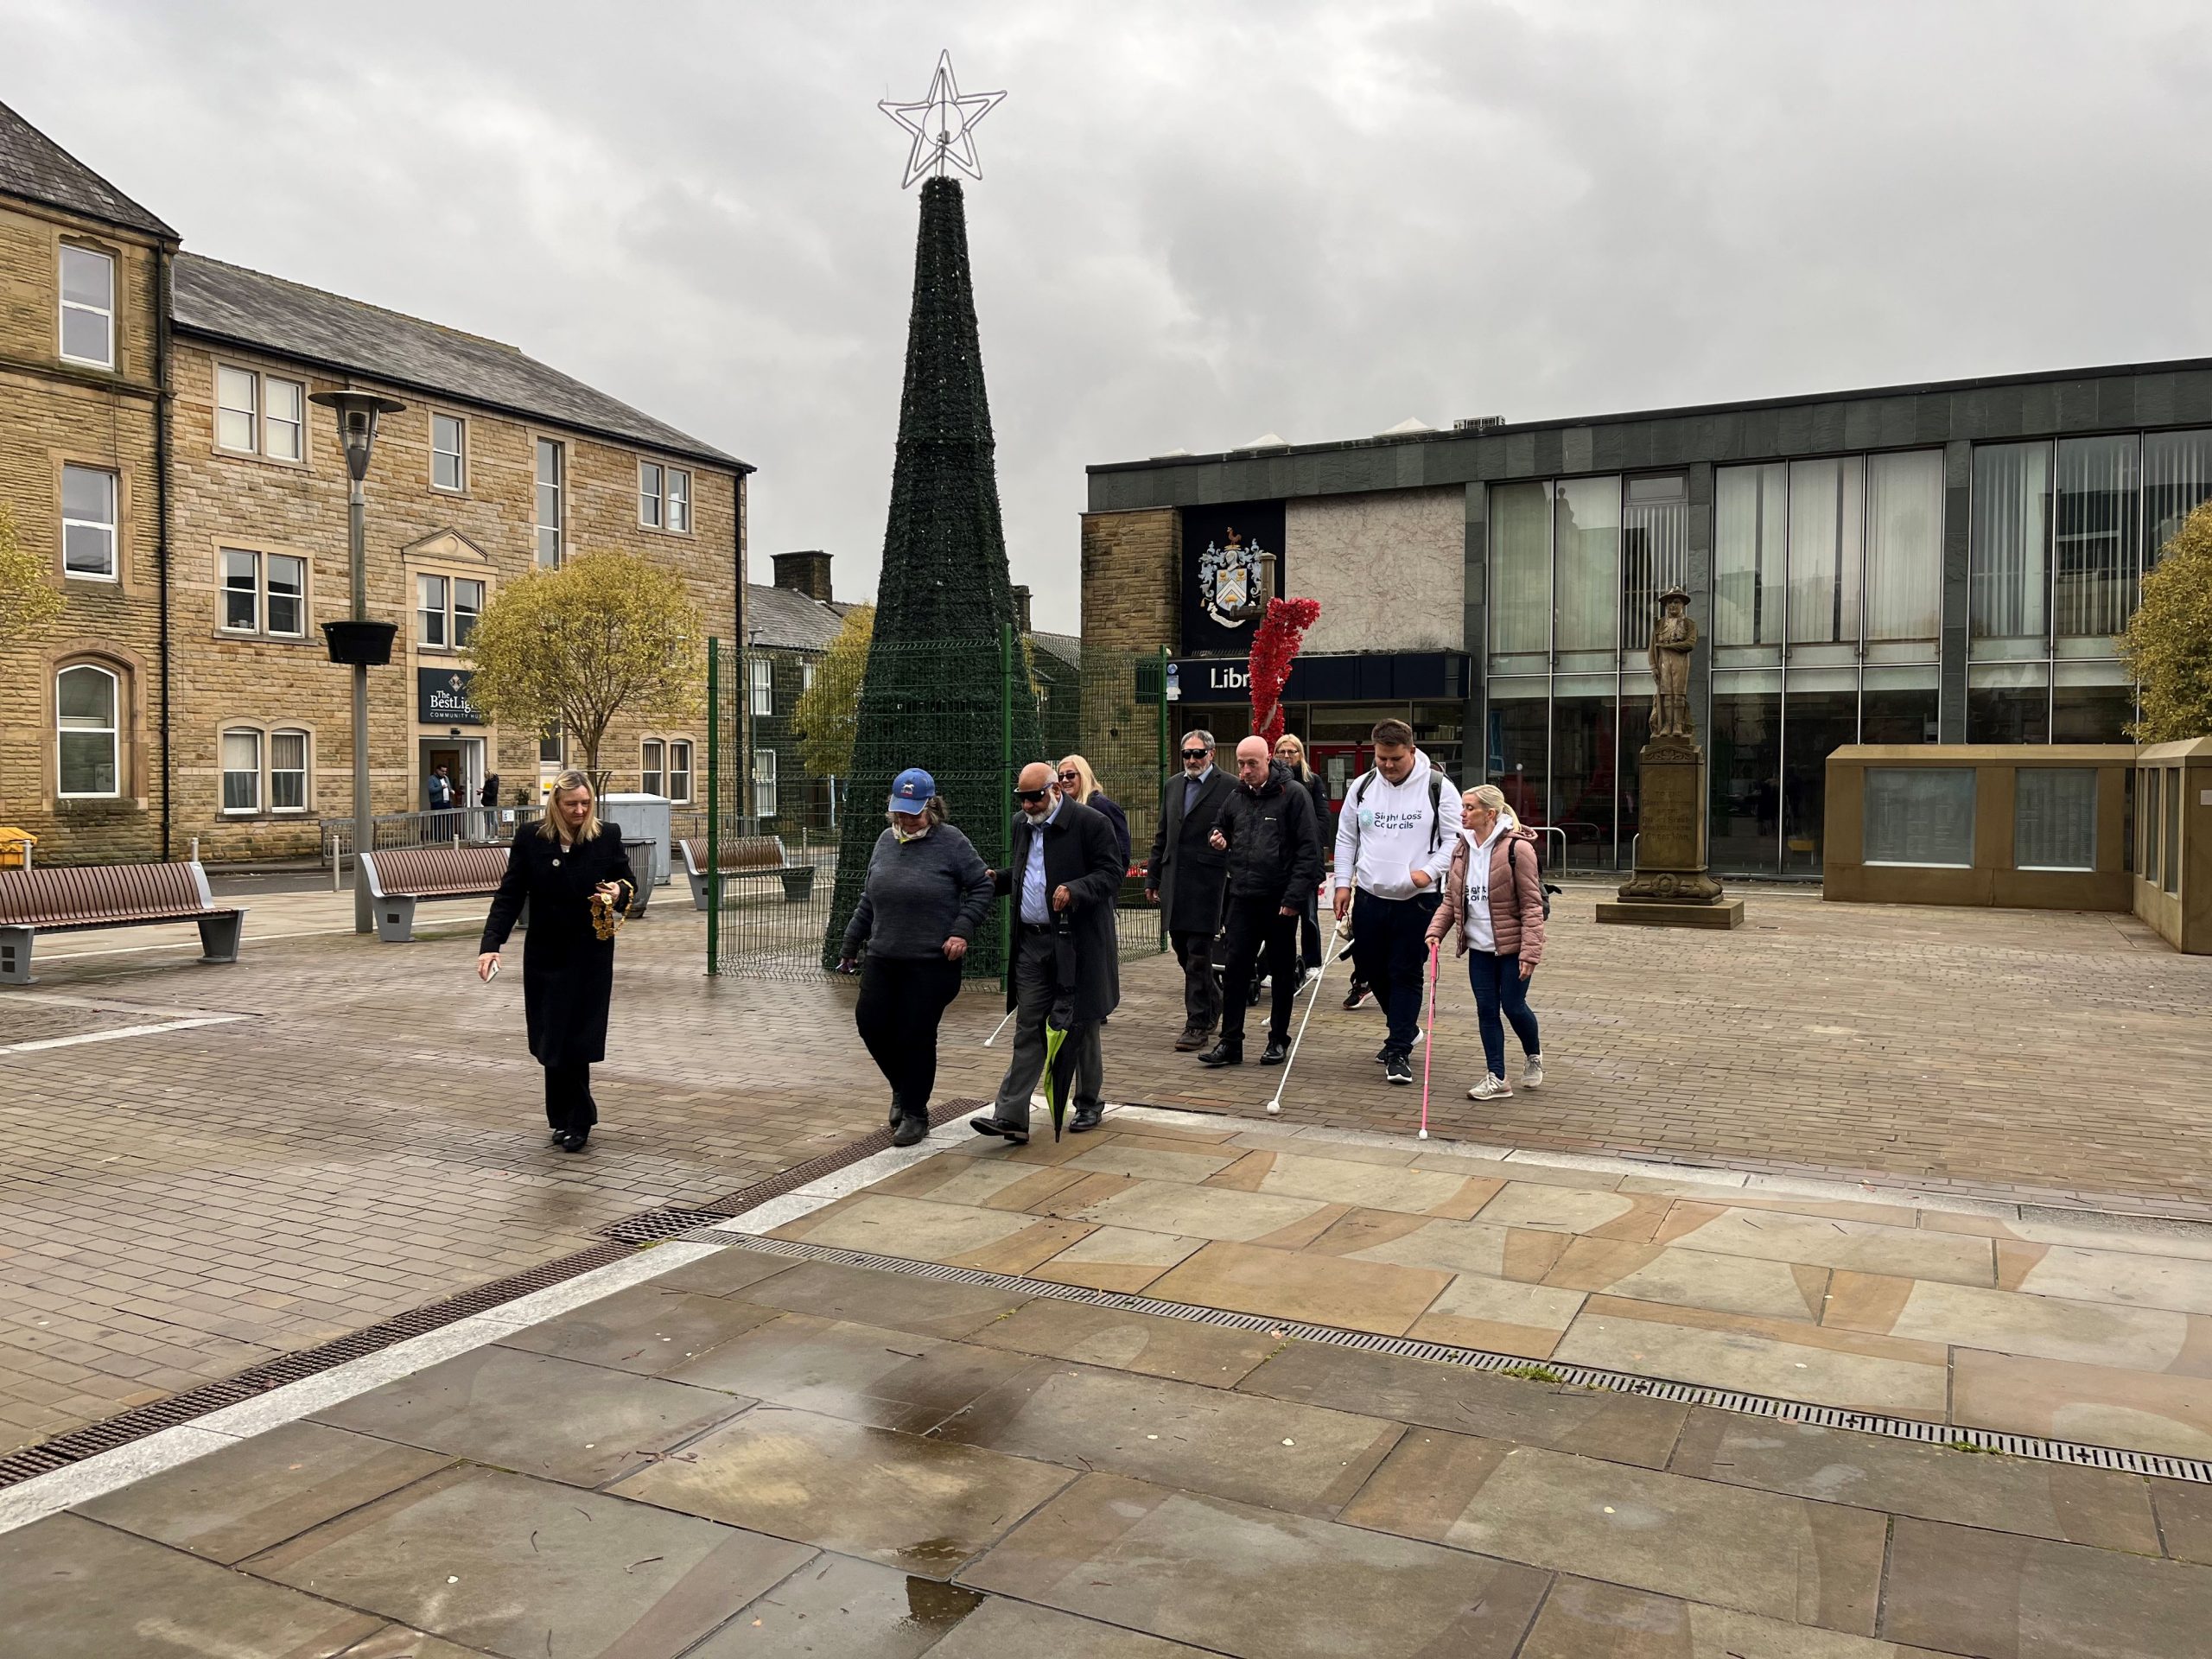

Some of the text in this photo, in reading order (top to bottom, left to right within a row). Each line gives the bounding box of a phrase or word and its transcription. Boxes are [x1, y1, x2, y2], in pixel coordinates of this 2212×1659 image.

[1211, 667, 1251, 689] Libr
[436, 690, 450, 699] The
[429, 695, 474, 714] BestLig
[1465, 885, 1487, 894] Sght
